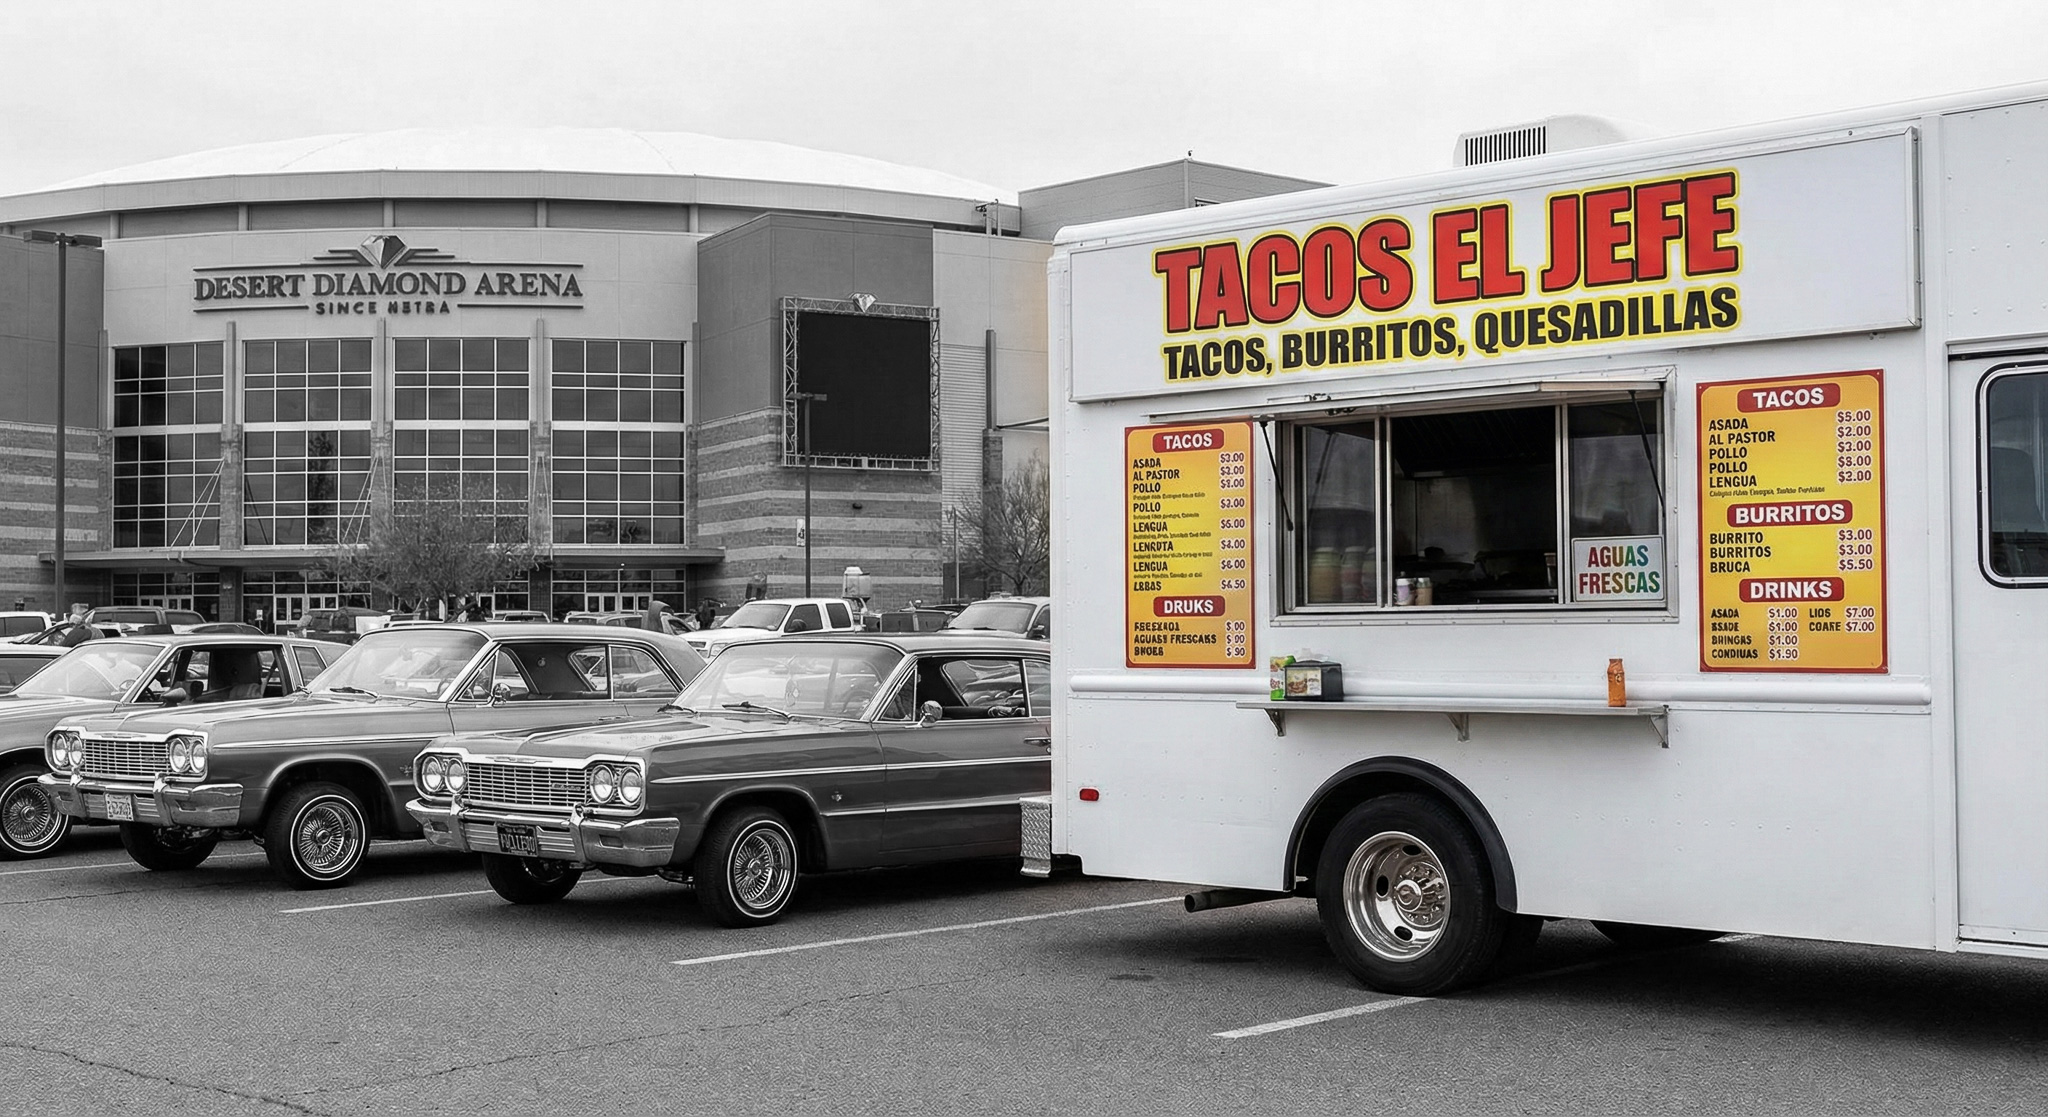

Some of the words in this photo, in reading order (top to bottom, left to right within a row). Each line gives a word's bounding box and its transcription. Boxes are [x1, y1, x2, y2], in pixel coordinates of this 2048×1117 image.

[1154, 218, 1413, 334] TACOS
[1433, 204, 1527, 305] EL
[1541, 172, 1740, 293] JEFE
[194, 274, 305, 300] DESERT
[312, 271, 466, 296] DIAMOND
[474, 272, 584, 297] ARENA
[315, 301, 377, 315] SINCE
[1164, 337, 1272, 380] TACOS,
[1282, 316, 1465, 369] BURRITOS,
[1474, 286, 1739, 353] QUESADILLAS
[1753, 387, 1825, 409] TACOS
[1709, 418, 1749, 431] ASADA
[1163, 433, 1212, 449] TACOS
[1709, 434, 1724, 446] AL
[1728, 431, 1776, 444] PASTOR
[1709, 446, 1748, 460] POLLO
[1133, 458, 1161, 469] ASADA
[1709, 461, 1748, 474] POLLO
[1133, 471, 1144, 481] AL
[1146, 469, 1180, 480] PASTOR
[1709, 475, 1757, 488] LENGUA
[1133, 482, 1161, 493] POLLO
[1133, 502, 1161, 513] POLLO
[1735, 503, 1845, 524] BURRITOS
[1710, 532, 1764, 545] BURRITO
[1838, 529, 1873, 542] $3.00
[1588, 545, 1649, 568] AGUAS
[1710, 546, 1771, 559] BURRITOS
[1838, 544, 1873, 556] $3.00
[1133, 561, 1168, 572] LENGUA
[1710, 561, 1751, 573] BRUCA
[1579, 571, 1660, 594] FRESCAS
[1750, 581, 1832, 599] DRINKS
[1164, 600, 1214, 614] DRUKS
[1711, 608, 1740, 619] ASADA
[1845, 607, 1874, 618] $7.00
[1845, 621, 1874, 632] $7.00
